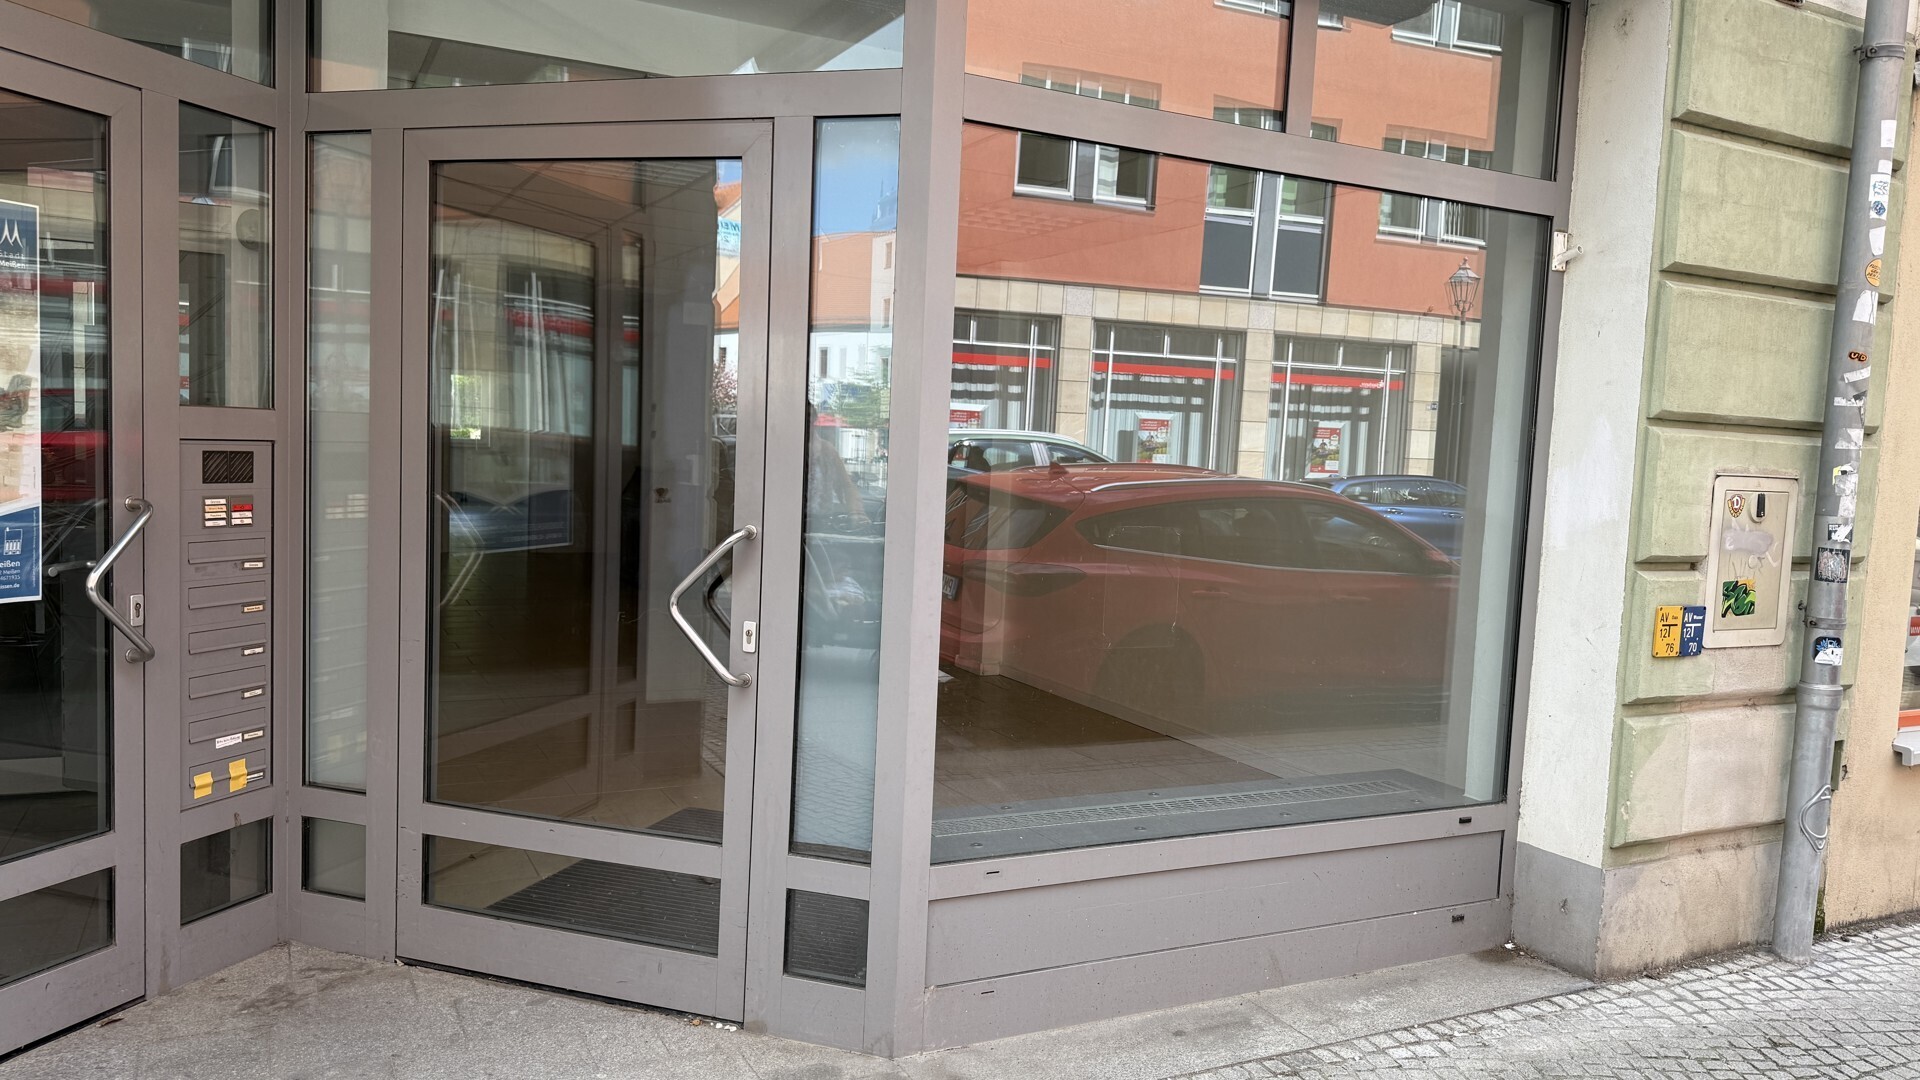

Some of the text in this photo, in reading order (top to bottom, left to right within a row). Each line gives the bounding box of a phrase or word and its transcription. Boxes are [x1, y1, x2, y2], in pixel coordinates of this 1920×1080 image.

[0, 559, 21, 568] eißen
[1660, 612, 1669, 622] AV
[1684, 612, 1693, 622] AV
[1688, 642, 1697, 652] 70
